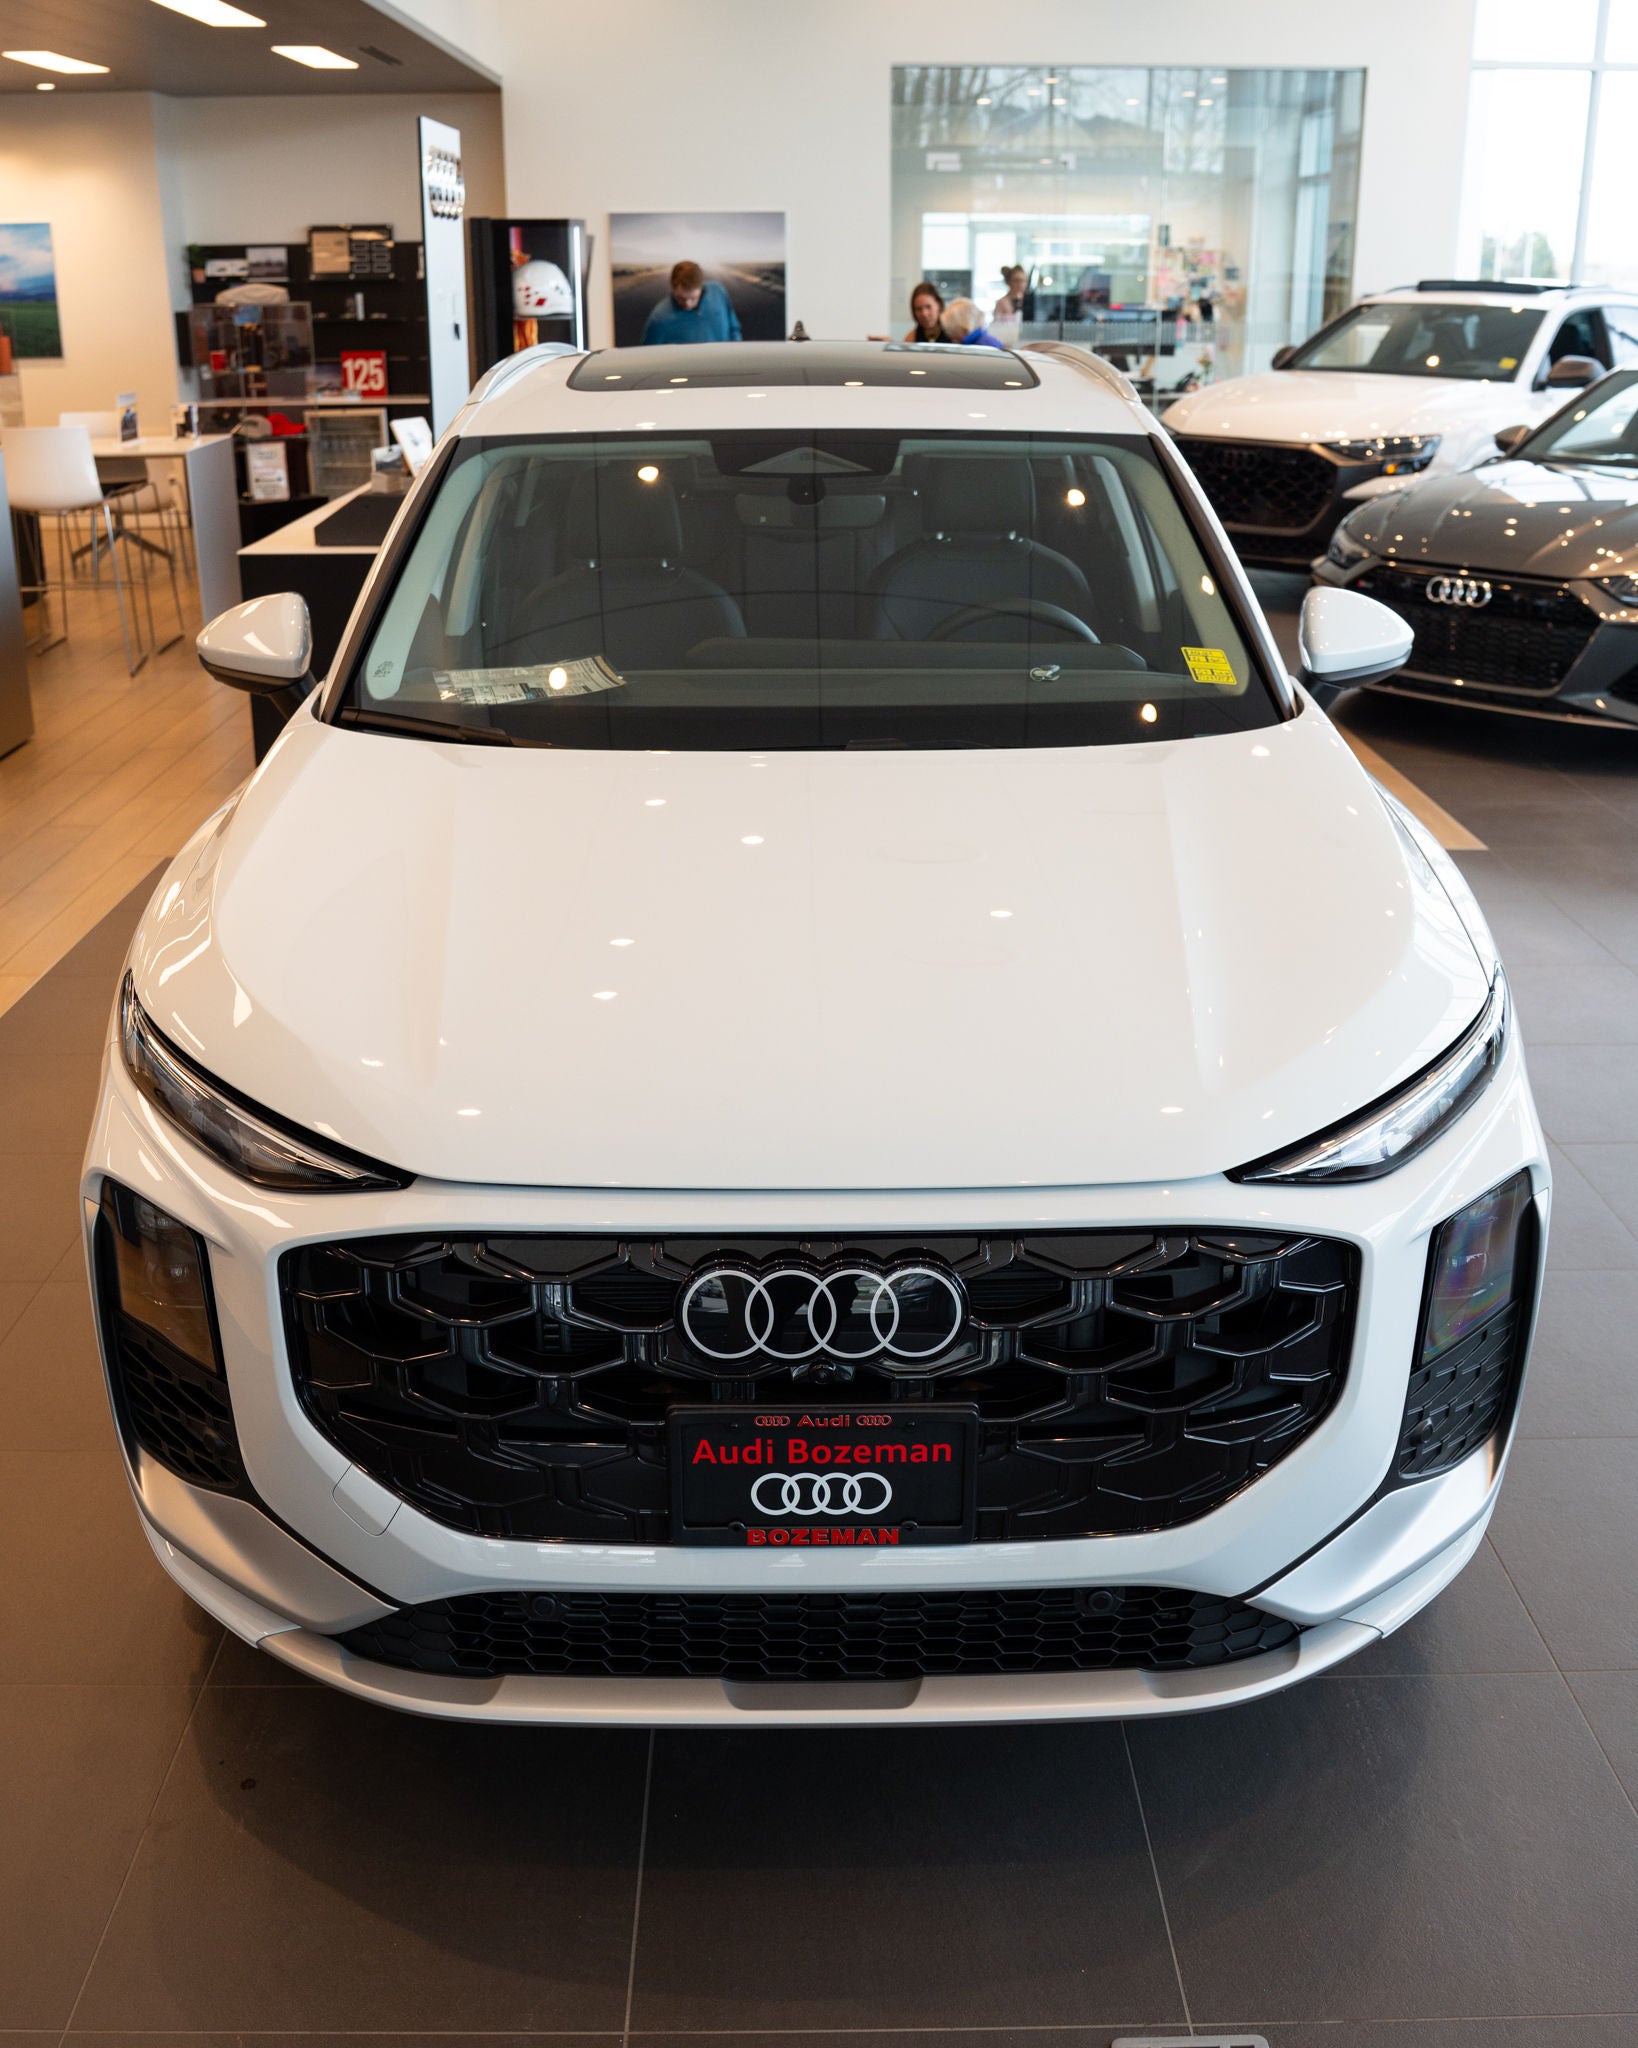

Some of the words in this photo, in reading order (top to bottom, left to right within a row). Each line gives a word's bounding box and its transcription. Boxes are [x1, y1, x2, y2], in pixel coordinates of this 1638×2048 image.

[342, 358, 385, 391] 125
[797, 1415, 850, 1428] Audi
[692, 1438, 774, 1465] Audi
[787, 1438, 952, 1465] Bozeman
[746, 1528, 899, 1546] BOZEMAN
